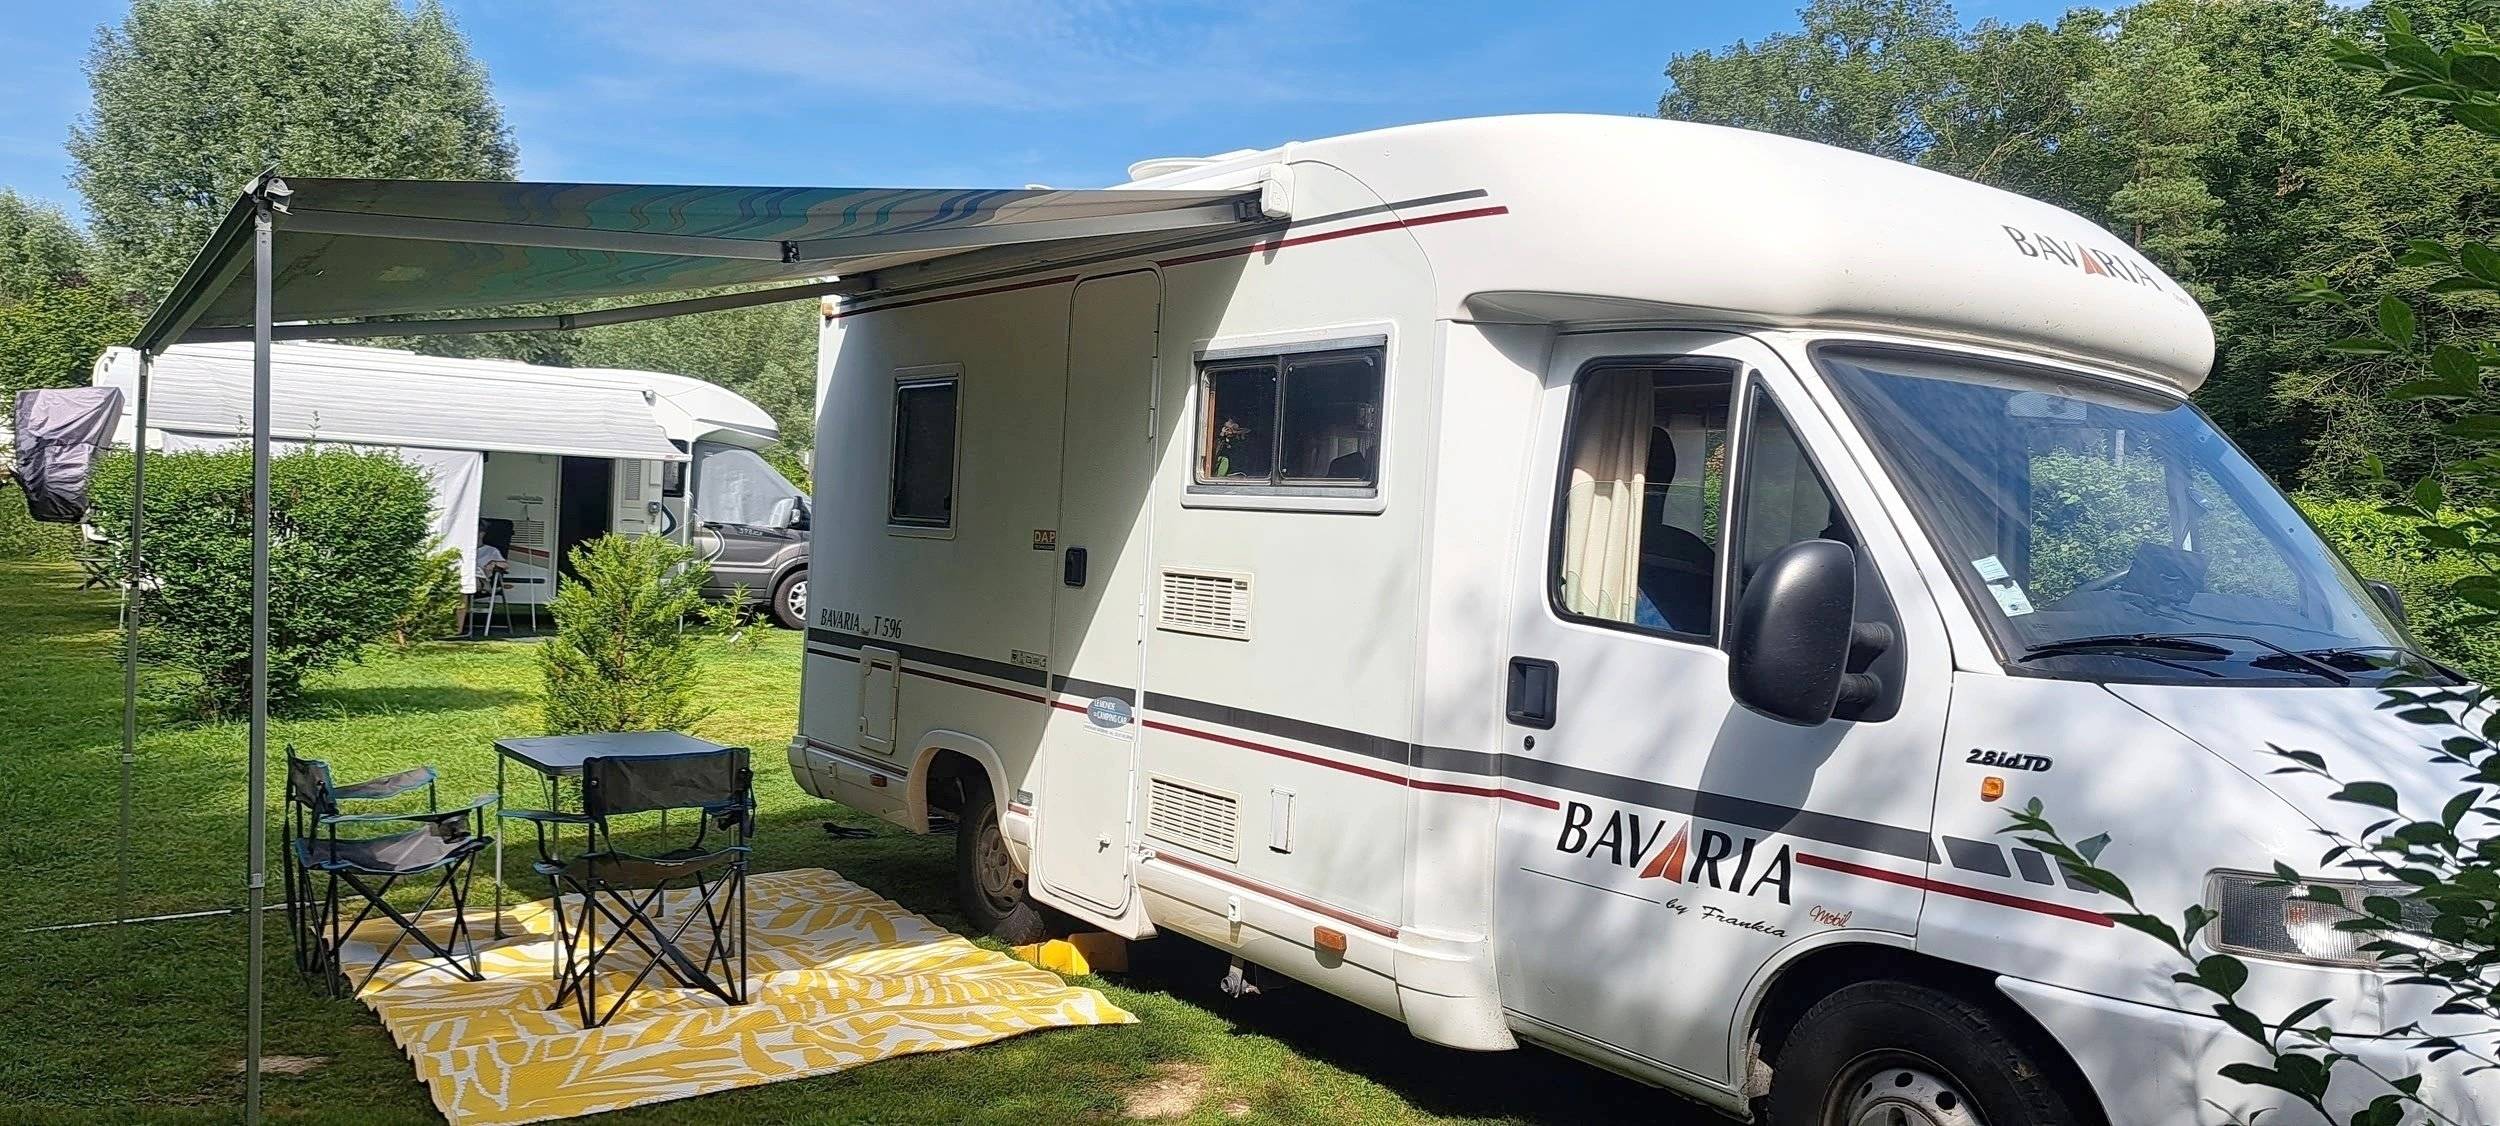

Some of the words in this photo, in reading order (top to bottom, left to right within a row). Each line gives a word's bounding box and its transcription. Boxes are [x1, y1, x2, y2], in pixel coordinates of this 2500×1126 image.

[2001, 224, 2164, 292] BAVARIA
[1034, 530, 1056, 543] DAP
[820, 608, 860, 632] BAVARIA
[874, 615, 882, 635] T
[882, 617, 902, 639] 596
[1556, 801, 1792, 905] BAVARIA
[1665, 898, 1688, 914] by
[1701, 905, 1787, 938] Frankia
[1809, 905, 1853, 928] Mobil
